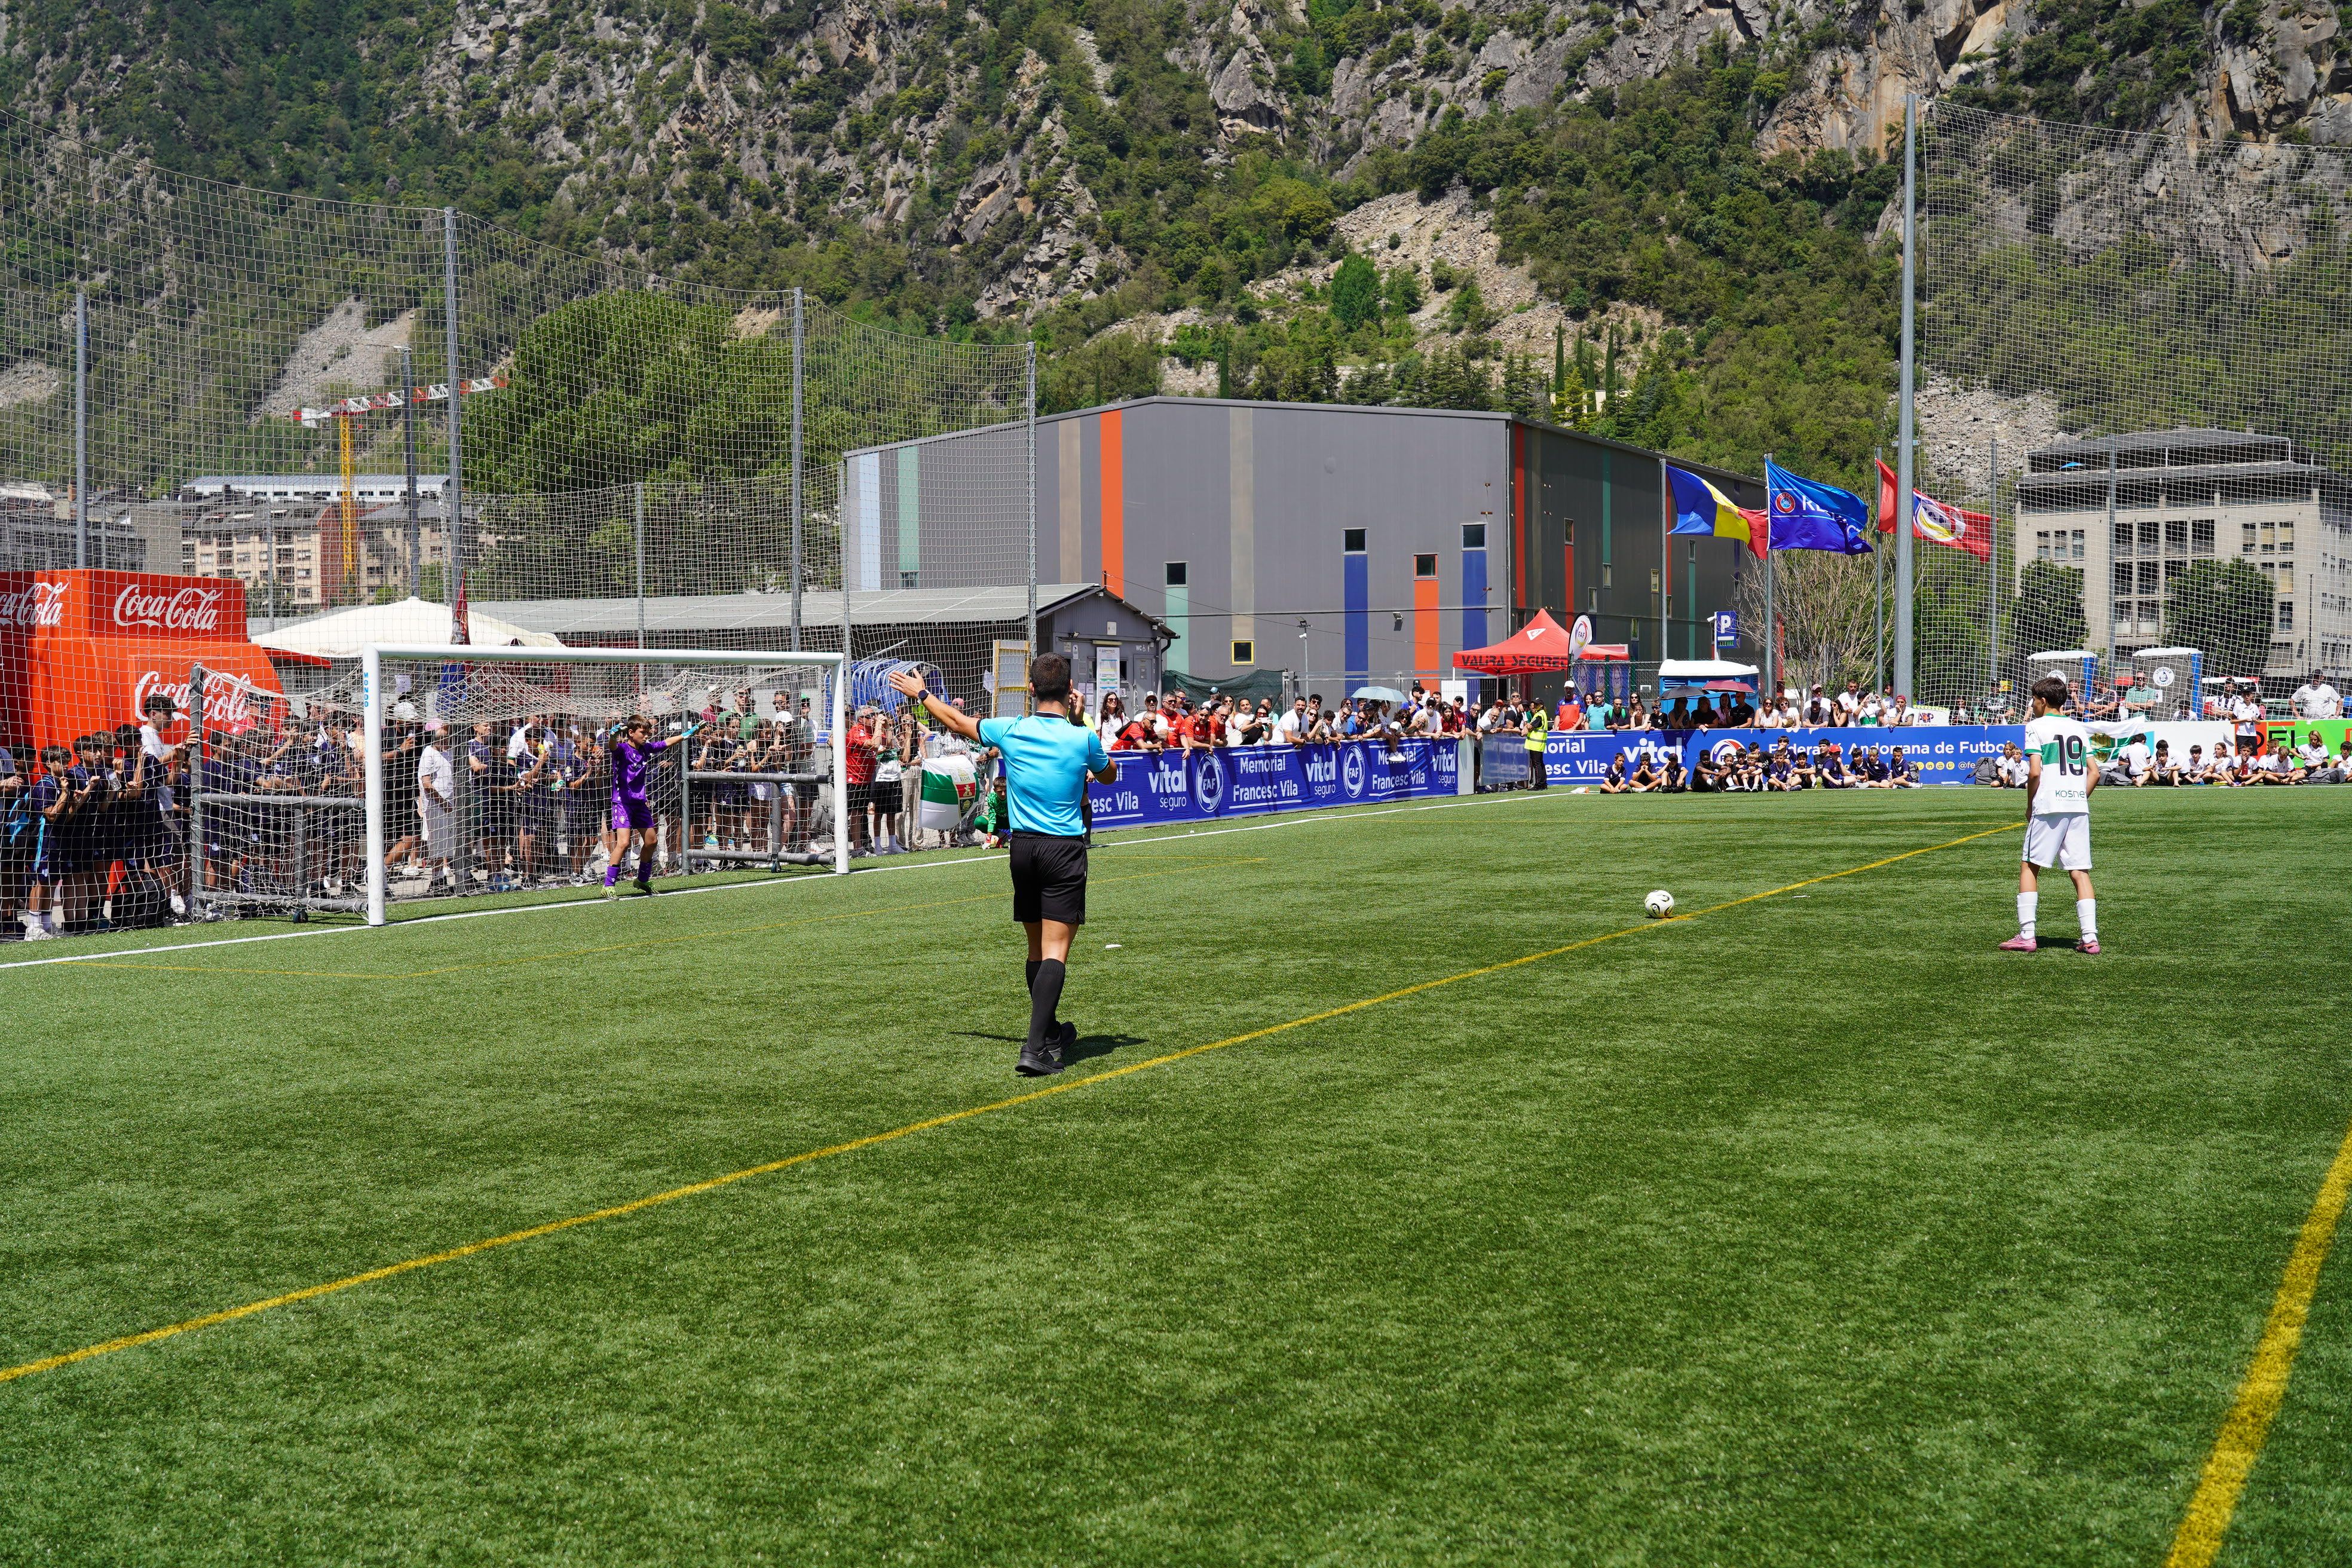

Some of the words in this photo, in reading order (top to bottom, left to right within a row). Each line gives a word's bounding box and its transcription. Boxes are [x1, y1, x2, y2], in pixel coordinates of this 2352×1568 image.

[0, 581, 69, 626] ca-Cola
[114, 584, 223, 630] Coca-Cola
[1721, 615, 1731, 633] P
[1378, 747, 1416, 765] Merial
[1544, 739, 1585, 754] orial
[1622, 737, 1683, 764] vital
[1935, 741, 1954, 754] de
[1960, 740, 2010, 754] Futbo
[2053, 734, 2084, 776] 19
[1240, 754, 1286, 774] Memorial
[1306, 751, 1336, 782] vital
[1432, 744, 1456, 772] vital
[1576, 760, 1608, 774] Vila
[1148, 759, 1187, 794] vital
[1349, 767, 1359, 778] FAF
[1372, 773, 1410, 790] Francesc
[1410, 769, 1425, 785] Vila
[1438, 774, 1456, 786] seguro
[1203, 777, 1215, 791] FAF
[1233, 784, 1278, 802] Francesc
[1279, 780, 1298, 797] Vila
[1315, 784, 1336, 798] seguro
[1116, 791, 1138, 811] Vila
[1159, 796, 1187, 811] seguro
